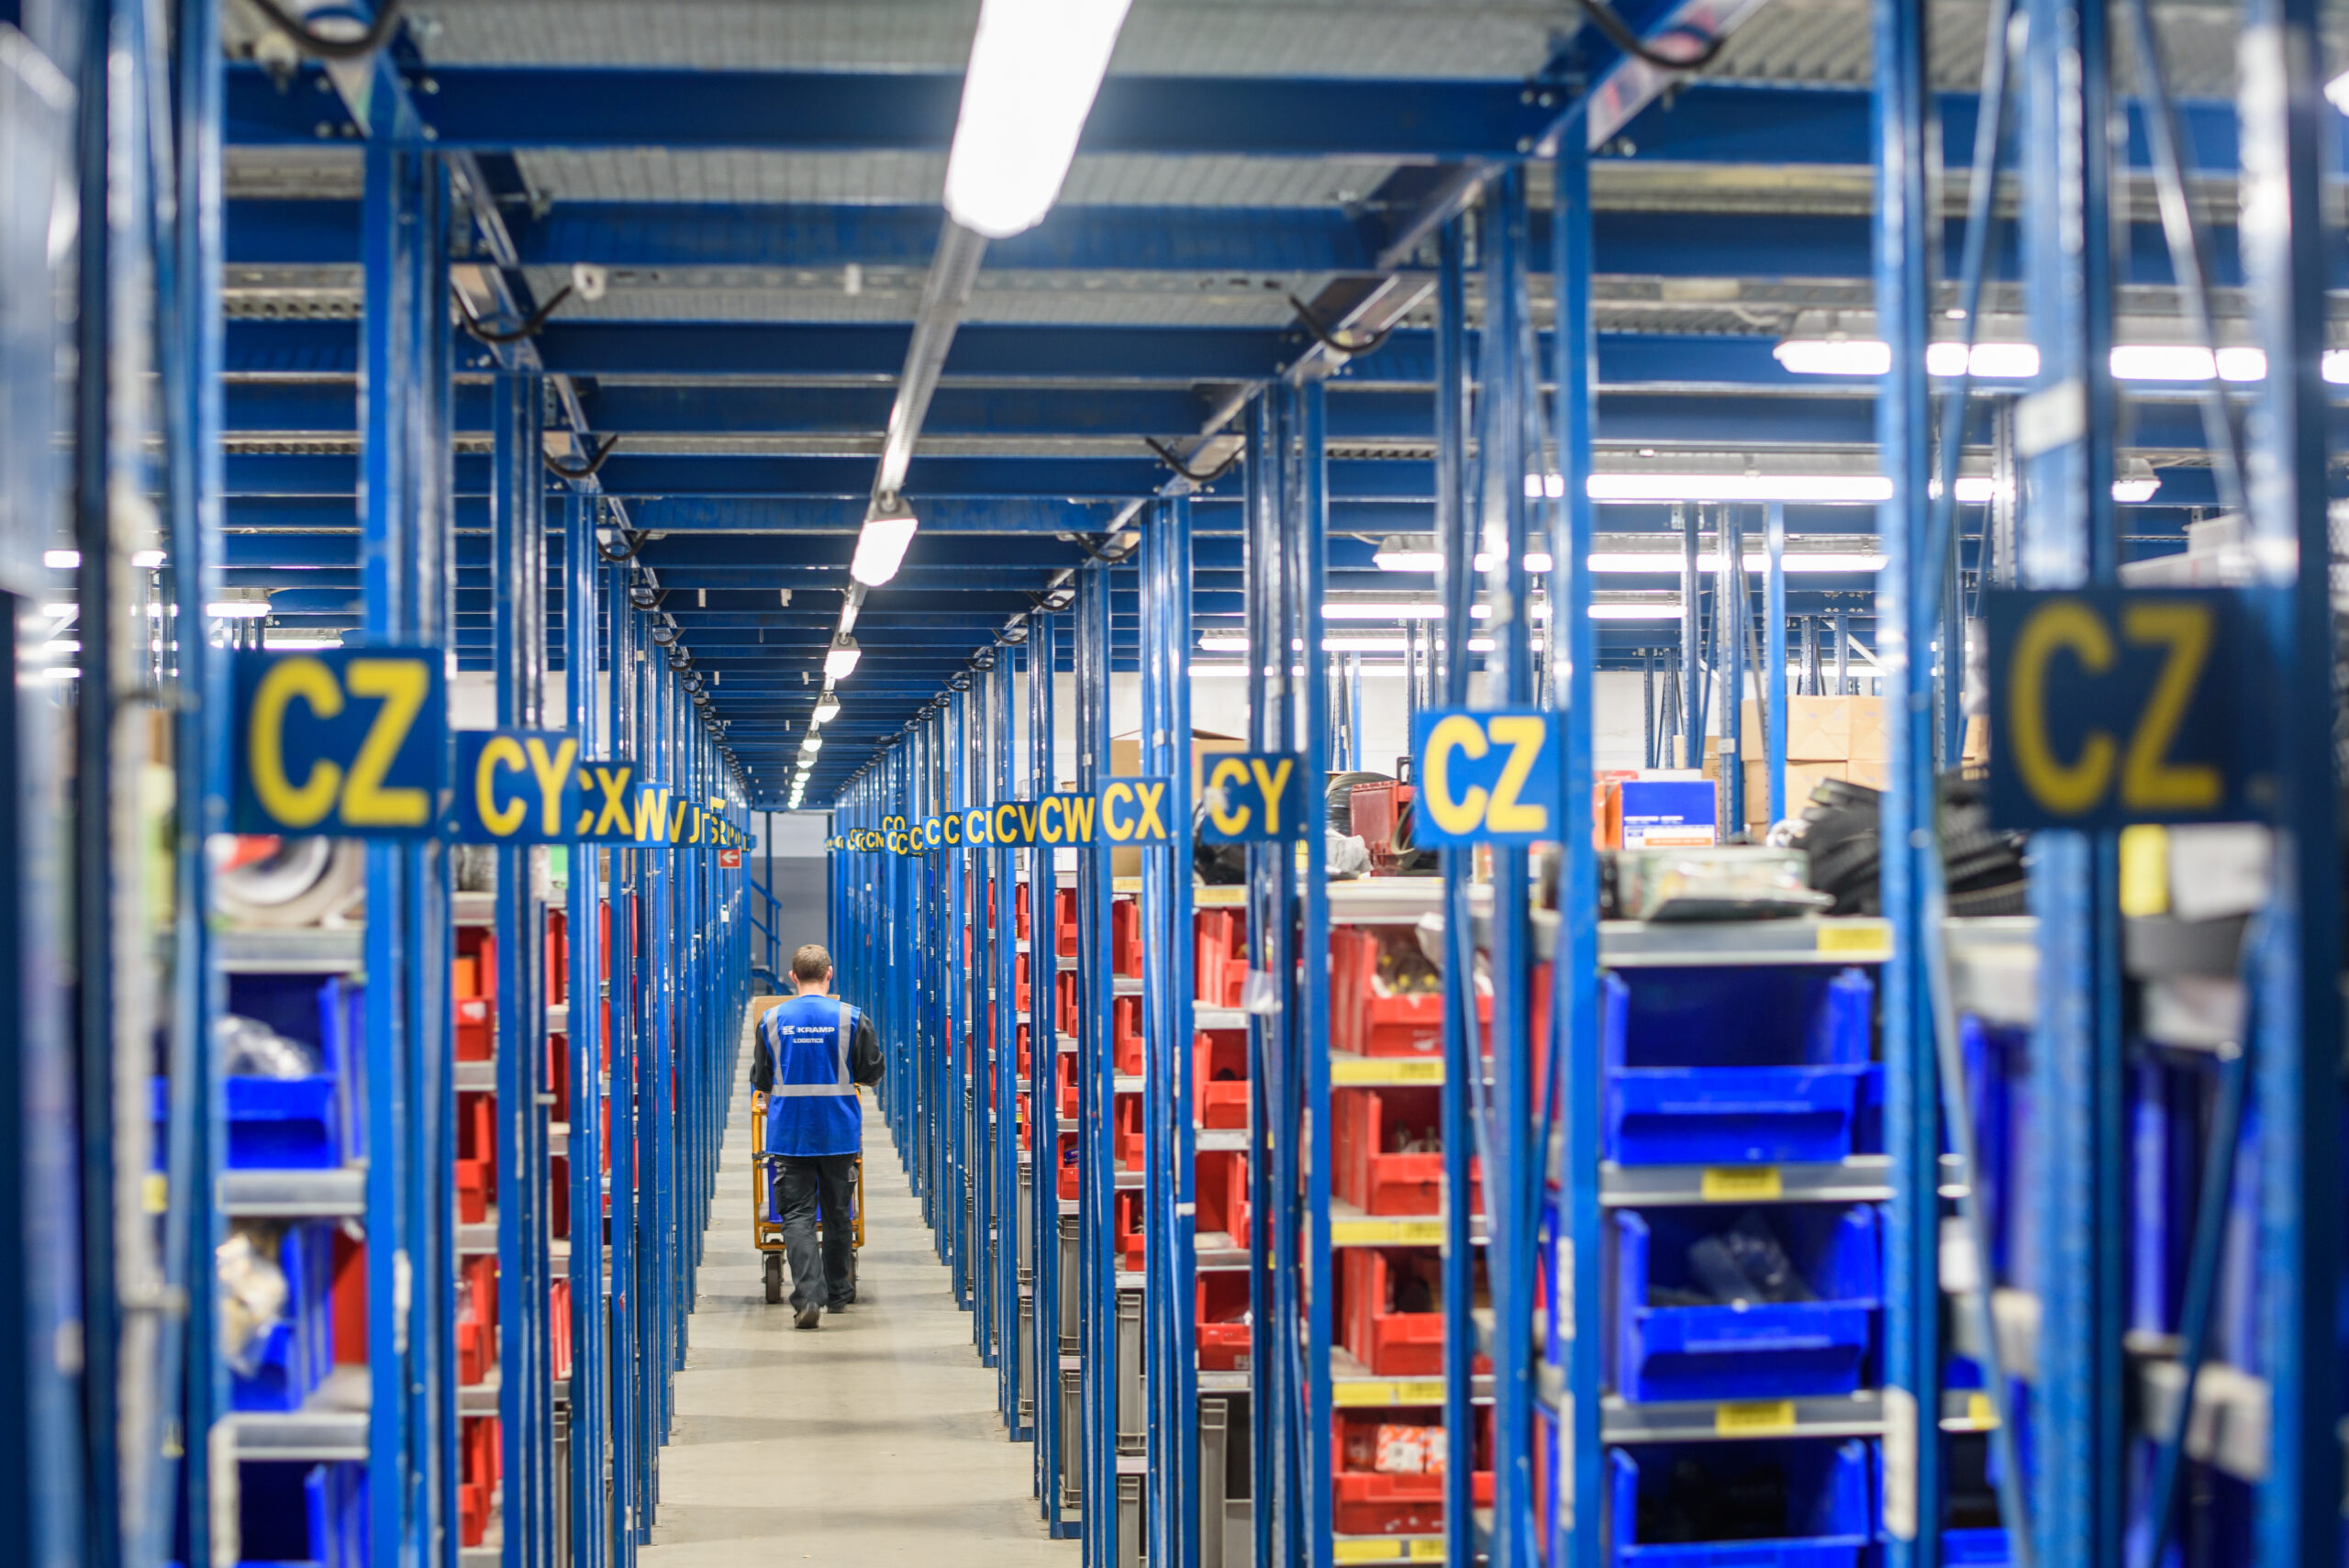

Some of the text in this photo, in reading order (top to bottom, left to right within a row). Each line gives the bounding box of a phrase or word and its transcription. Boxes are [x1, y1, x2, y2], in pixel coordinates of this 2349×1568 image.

[2009, 601, 2220, 813] CZ
[250, 658, 429, 828] CZ
[1423, 716, 1547, 834] CZ
[475, 737, 578, 836] CY
[635, 788, 668, 841] W
[1039, 795, 1096, 843] CW
[1102, 782, 1166, 840] CX
[1210, 758, 1292, 836] CY
[670, 801, 686, 843] V
[995, 805, 1037, 843] CV
